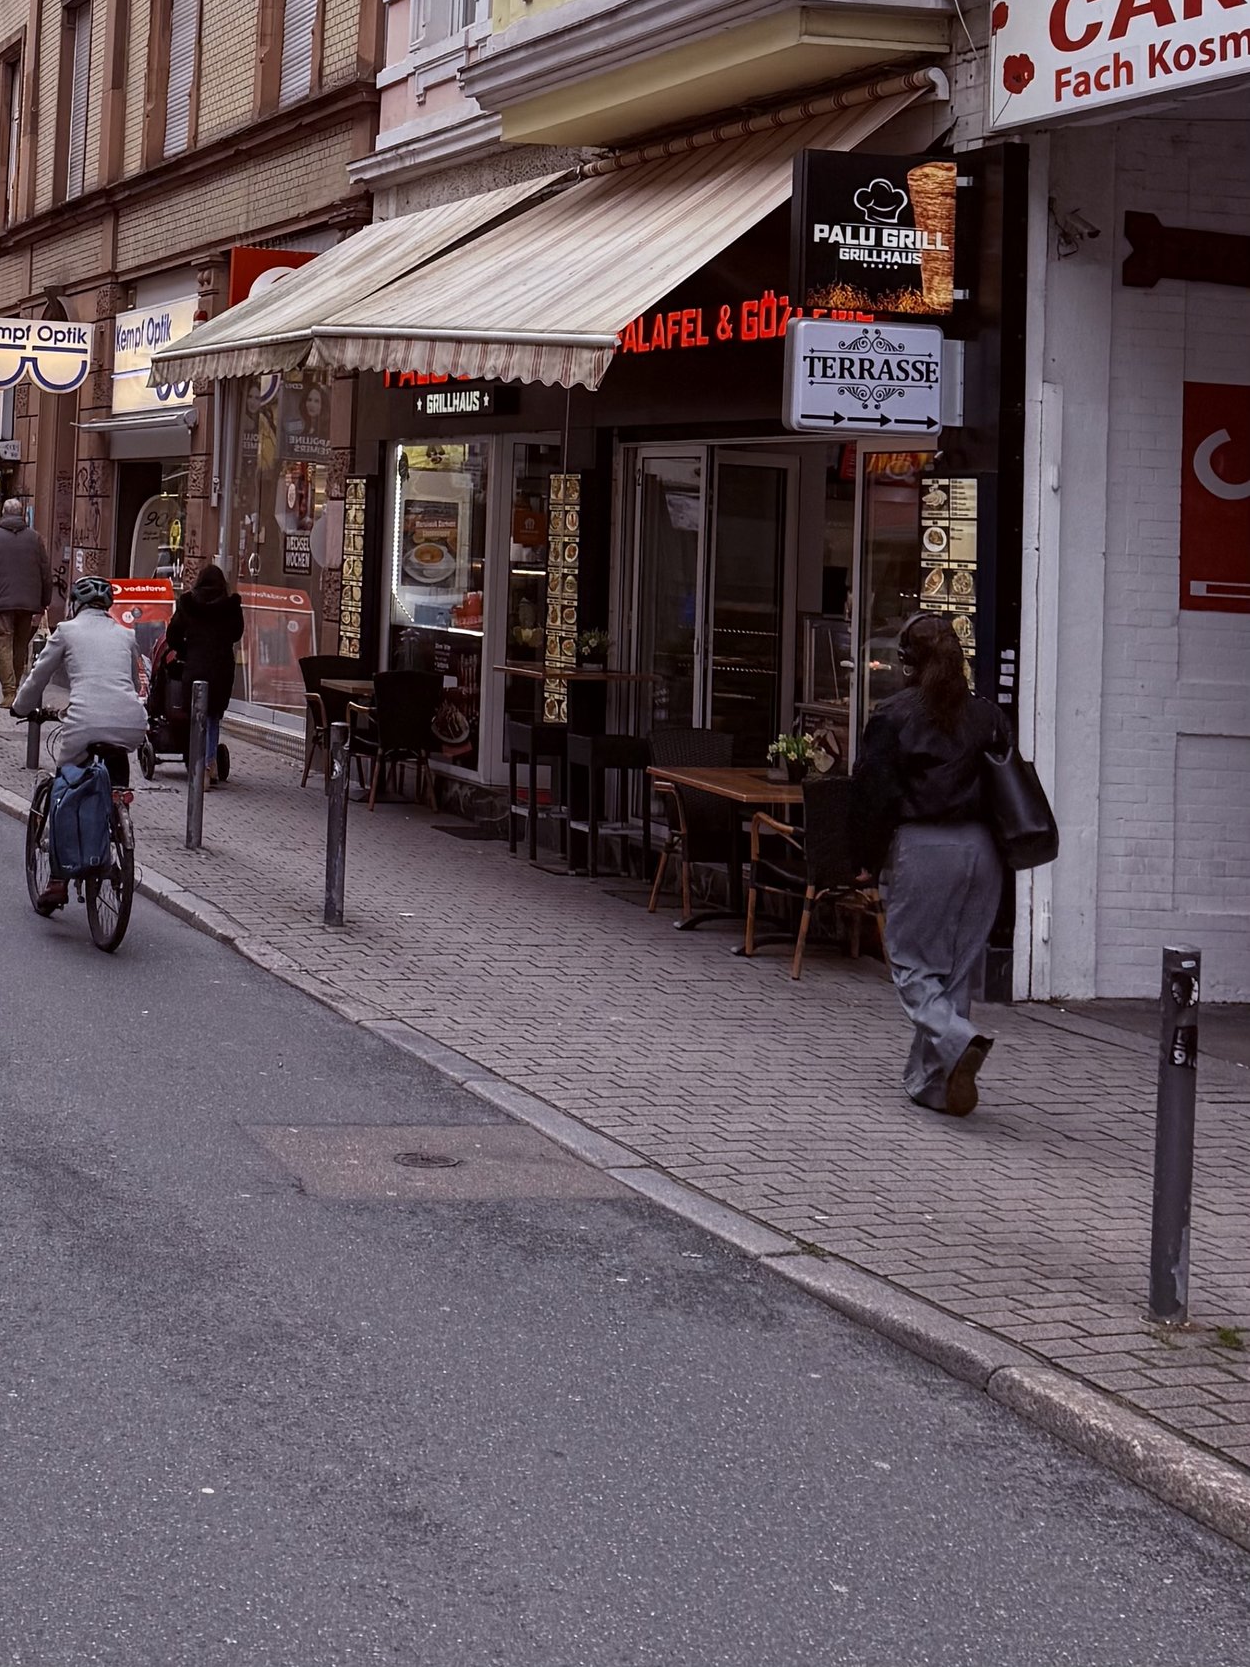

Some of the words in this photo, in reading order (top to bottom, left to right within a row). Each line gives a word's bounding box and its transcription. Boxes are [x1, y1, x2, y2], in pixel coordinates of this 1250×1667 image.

[1055, 52, 1134, 102] Fach
[813, 223, 876, 246] PALU
[881, 228, 950, 252] GRILL
[839, 247, 923, 265] GRILLHAUS
[37, 325, 87, 345] Optik
[116, 319, 145, 353] Kempf
[146, 313, 172, 346] Optik
[716, 304, 734, 341] &
[803, 355, 939, 383] TERRASSE
[426, 390, 480, 415] GRILLHAUS
[123, 584, 167, 592] vodafone
